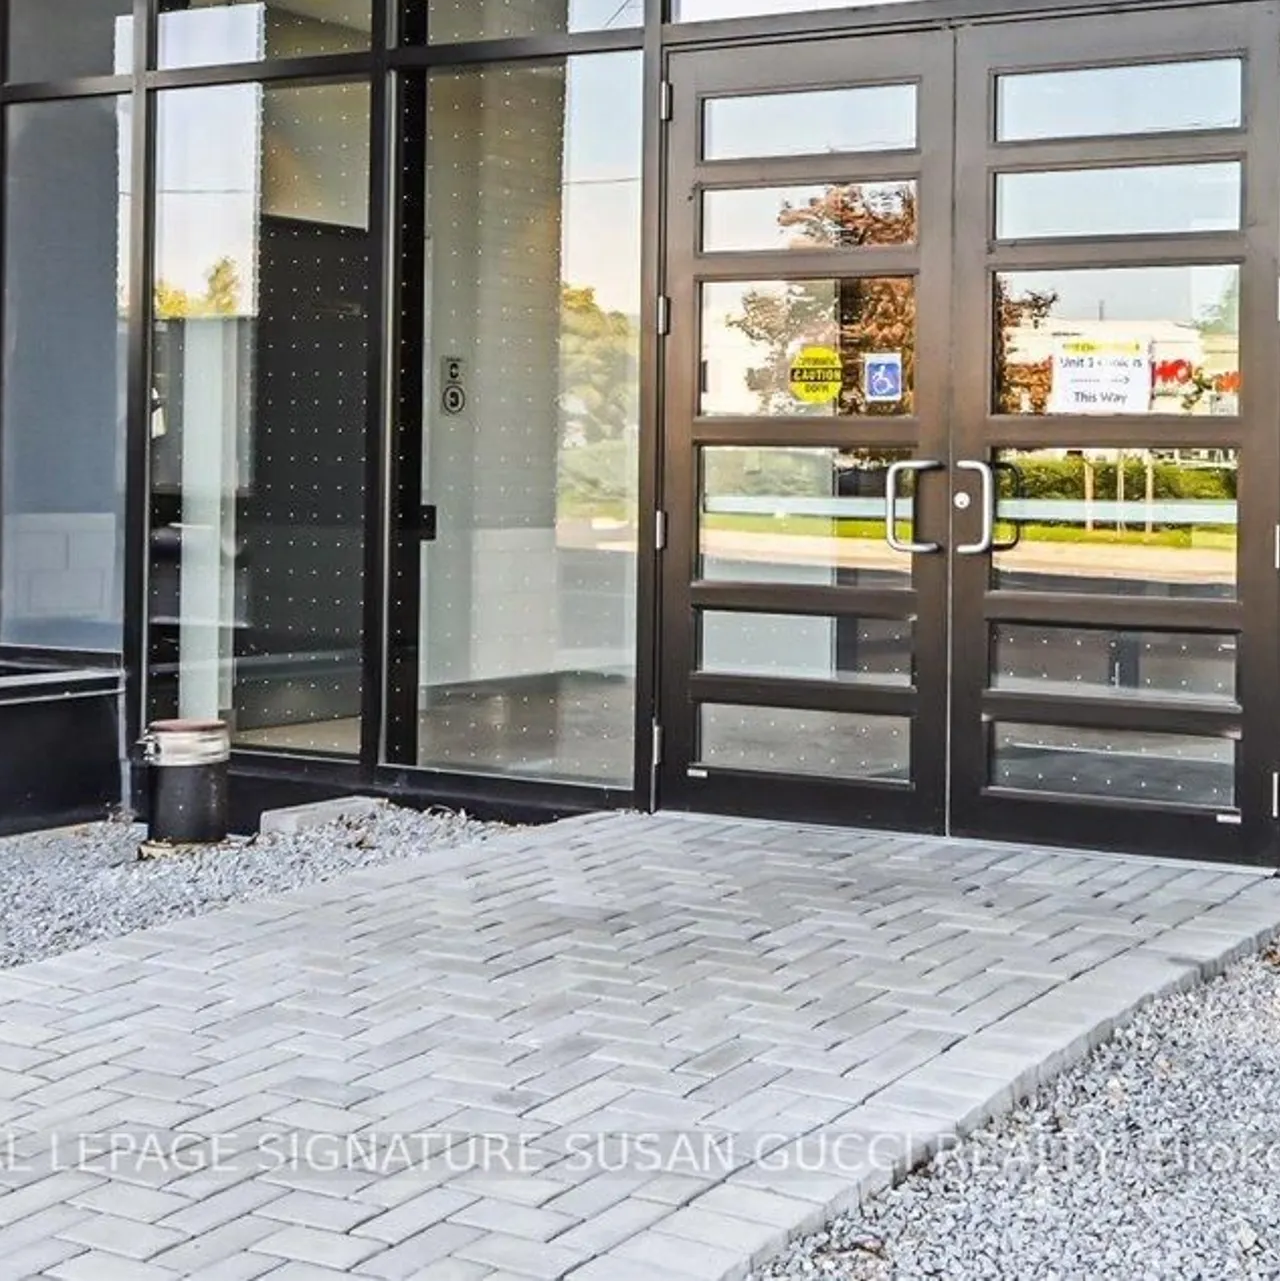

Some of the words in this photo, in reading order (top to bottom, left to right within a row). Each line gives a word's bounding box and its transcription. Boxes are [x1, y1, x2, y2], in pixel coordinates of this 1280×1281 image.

[793, 368, 841, 381] CAUTION
[1073, 392, 1097, 403] This
[1099, 392, 1128, 405] Way
